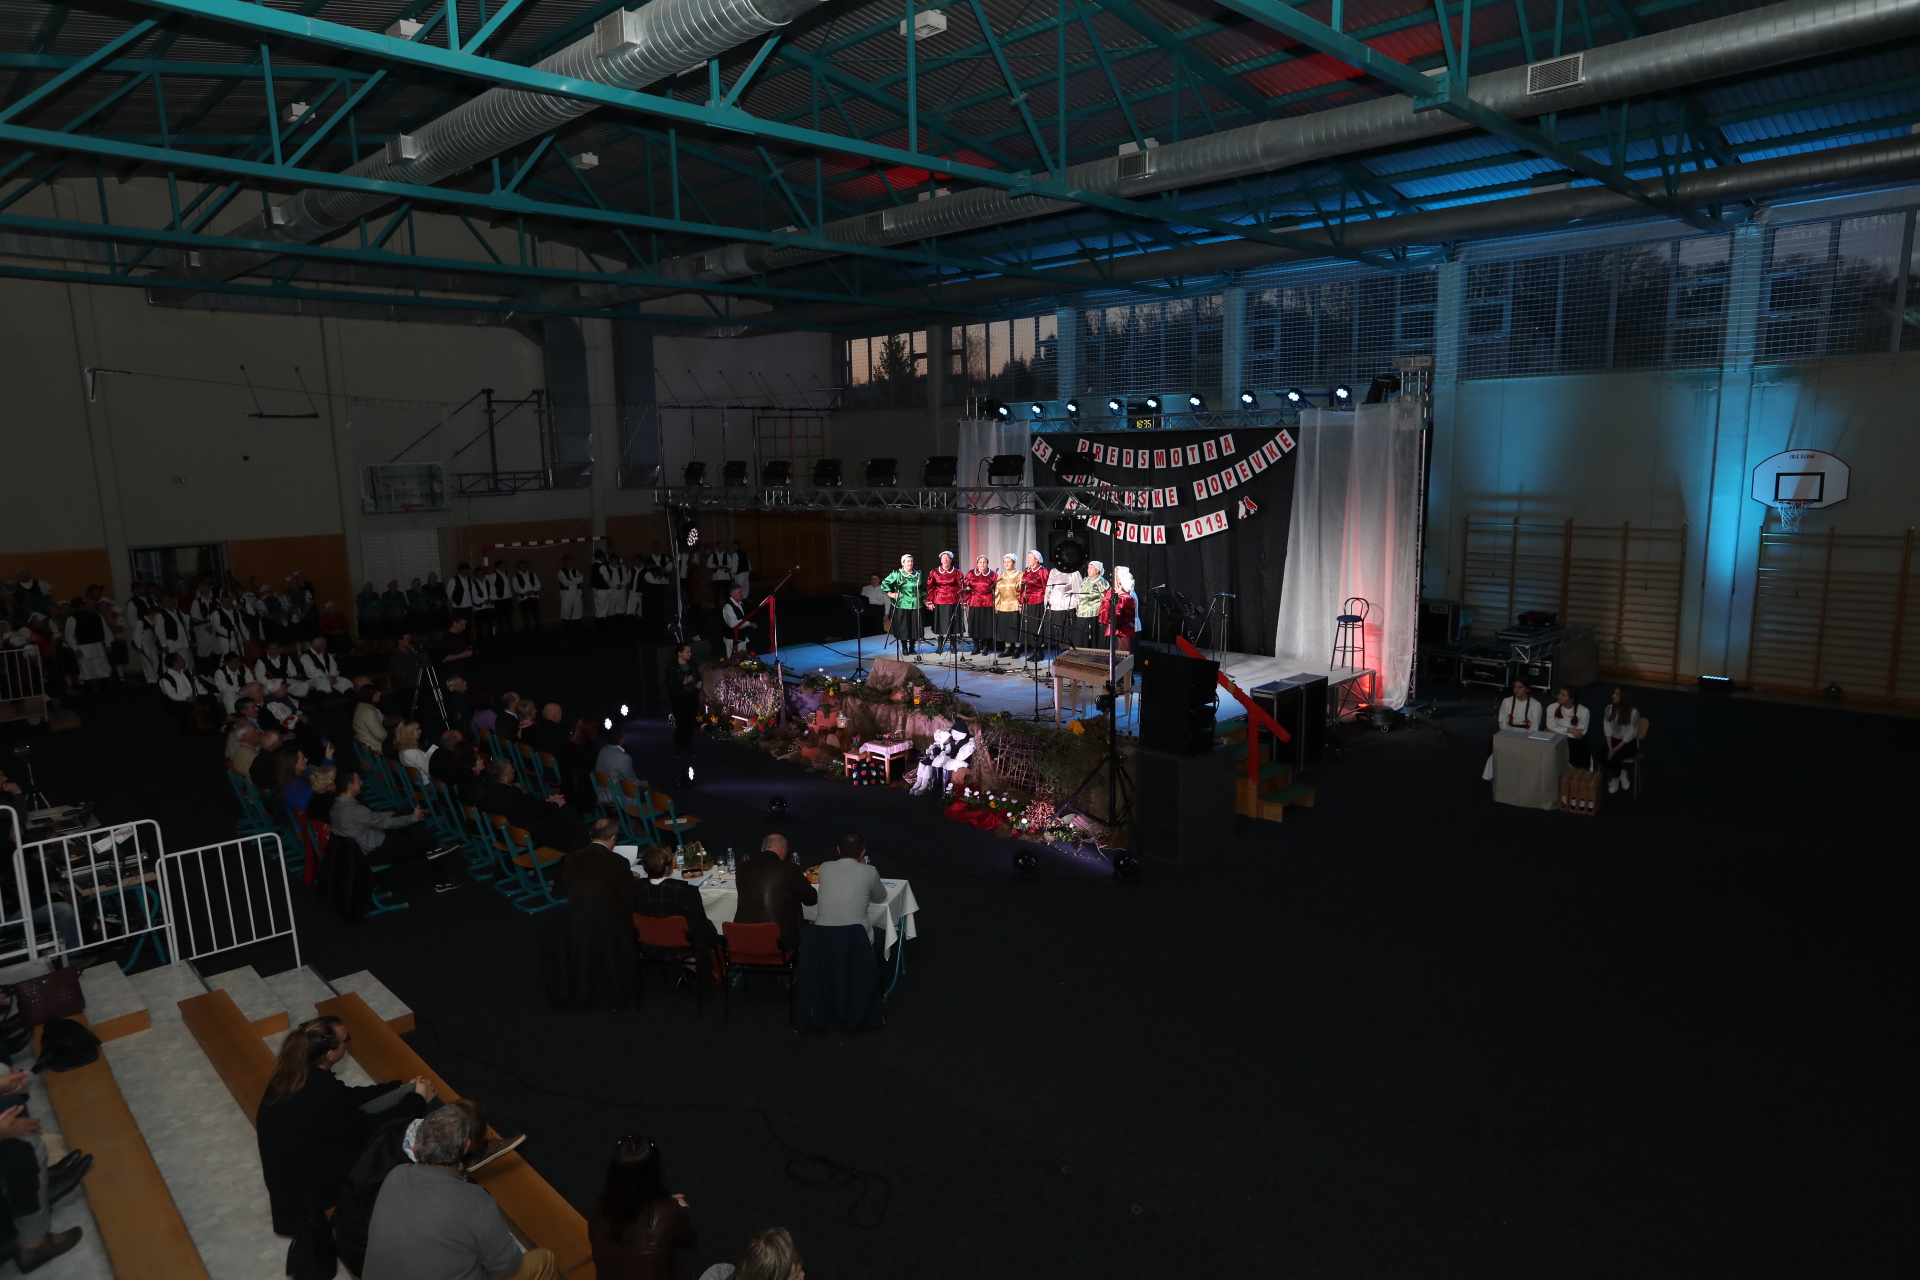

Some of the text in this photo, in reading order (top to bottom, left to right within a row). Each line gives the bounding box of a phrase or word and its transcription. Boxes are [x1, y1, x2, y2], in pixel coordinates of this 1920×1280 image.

[1033, 436, 1233, 466] 35. PREDSMOTRA
[1196, 432, 1292, 498] POPEVKE
[1184, 512, 1228, 540] 2019.
